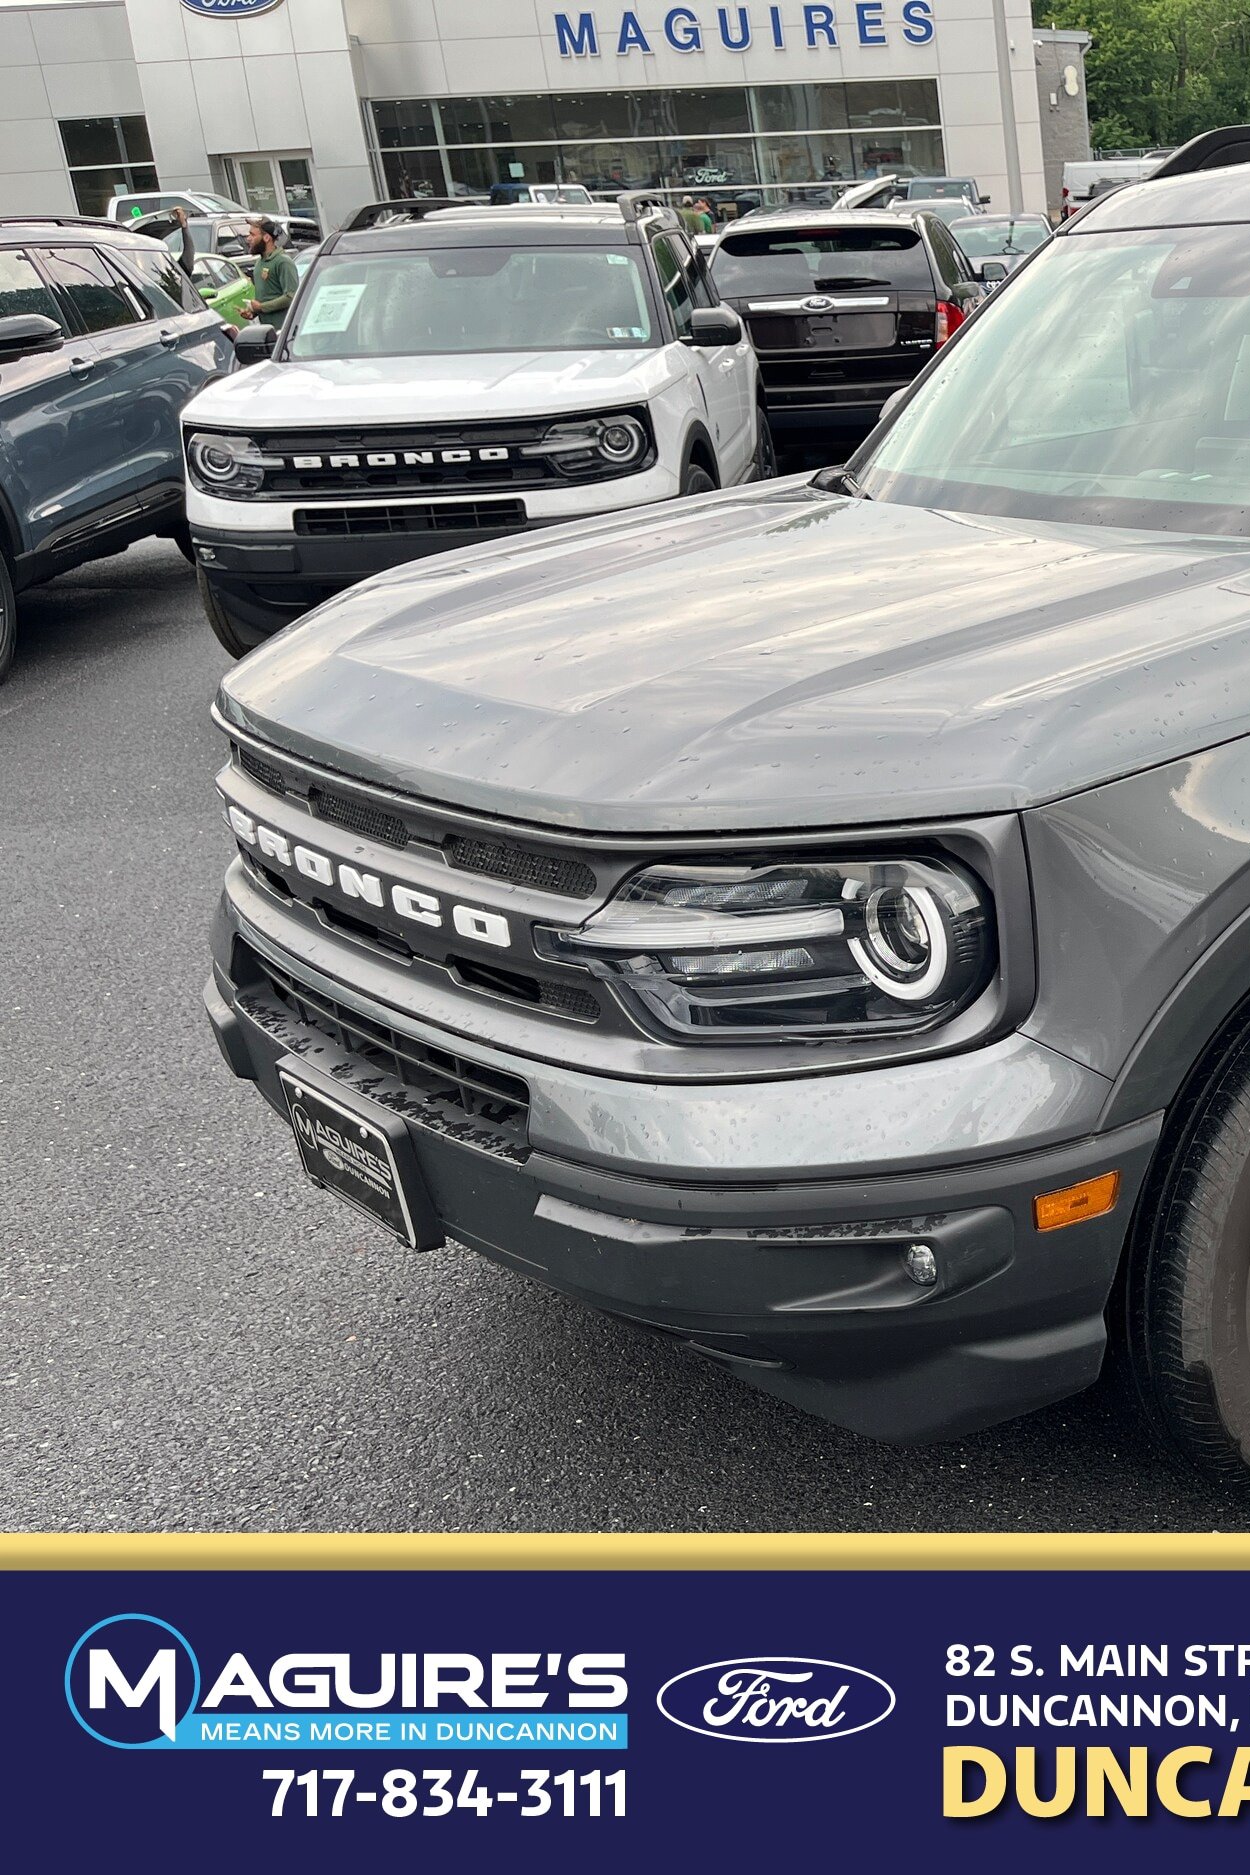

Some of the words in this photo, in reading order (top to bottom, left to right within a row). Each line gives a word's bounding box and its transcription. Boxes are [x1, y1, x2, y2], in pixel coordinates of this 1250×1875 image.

[552, 0, 935, 57] MAGUIRES
[694, 168, 728, 184] Ford
[292, 447, 509, 470] BRONCO
[229, 805, 511, 948] BRONCO
[294, 1110, 392, 1181] MAGUIRE'S
[344, 1162, 391, 1199] DUNCANNON
